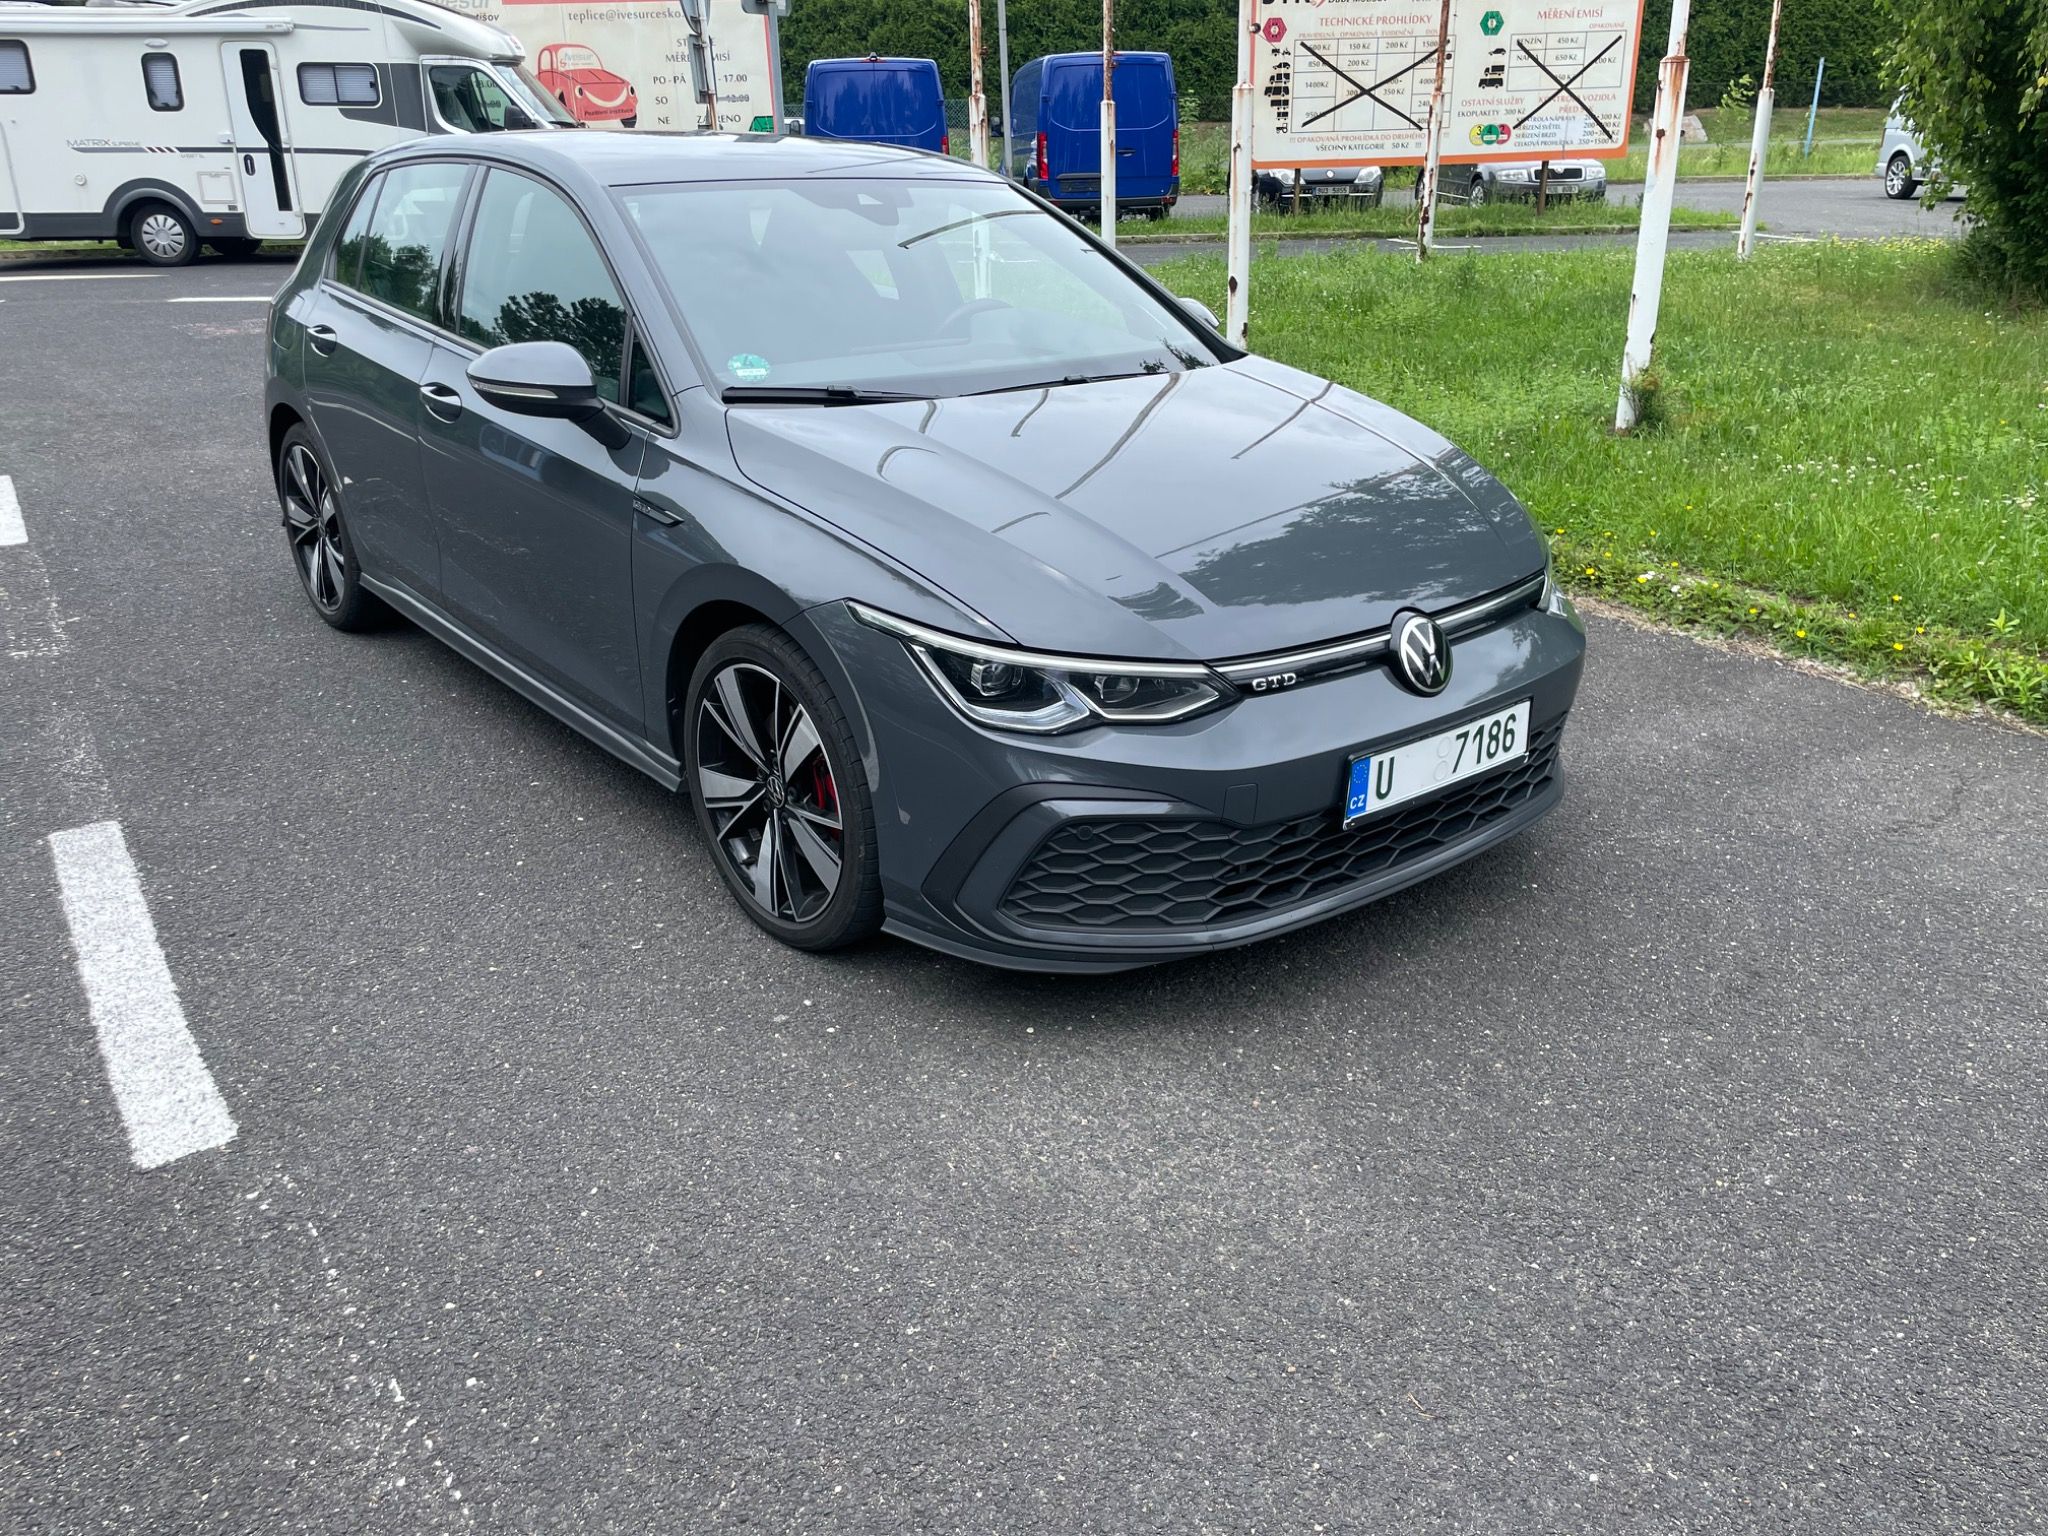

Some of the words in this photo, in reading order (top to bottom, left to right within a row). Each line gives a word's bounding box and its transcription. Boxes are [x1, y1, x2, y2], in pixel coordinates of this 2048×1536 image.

[1537, 8, 1575, 20] MĚŘENÍ
[1576, 7, 1603, 19] EMISÍ
[1319, 14, 1374, 27] TECHNICKÉ
[1376, 13, 1433, 26] PROHLÍDKY
[712, 50, 731, 61] MISÍ
[653, 76, 666, 85] PO
[673, 73, 687, 84] PÁ
[723, 74, 748, 83] 17.00
[655, 96, 668, 105] SO
[1461, 98, 1496, 107] OSTATNÍ
[657, 116, 671, 125] NE
[66, 139, 111, 147] MATRIX
[1297, 135, 1339, 143] OPAKOVANÁ
[1341, 133, 1380, 142] PROHLÍDKA
[1391, 132, 1426, 140] DRUHÉHO
[1315, 143, 1347, 151] VŠECHNY
[1348, 142, 1385, 150] KATEGORIE
[1252, 672, 1297, 691] GTD
[1350, 793, 1365, 809] CZ
[1375, 756, 1395, 801] U
[1452, 712, 1517, 775] 7186
